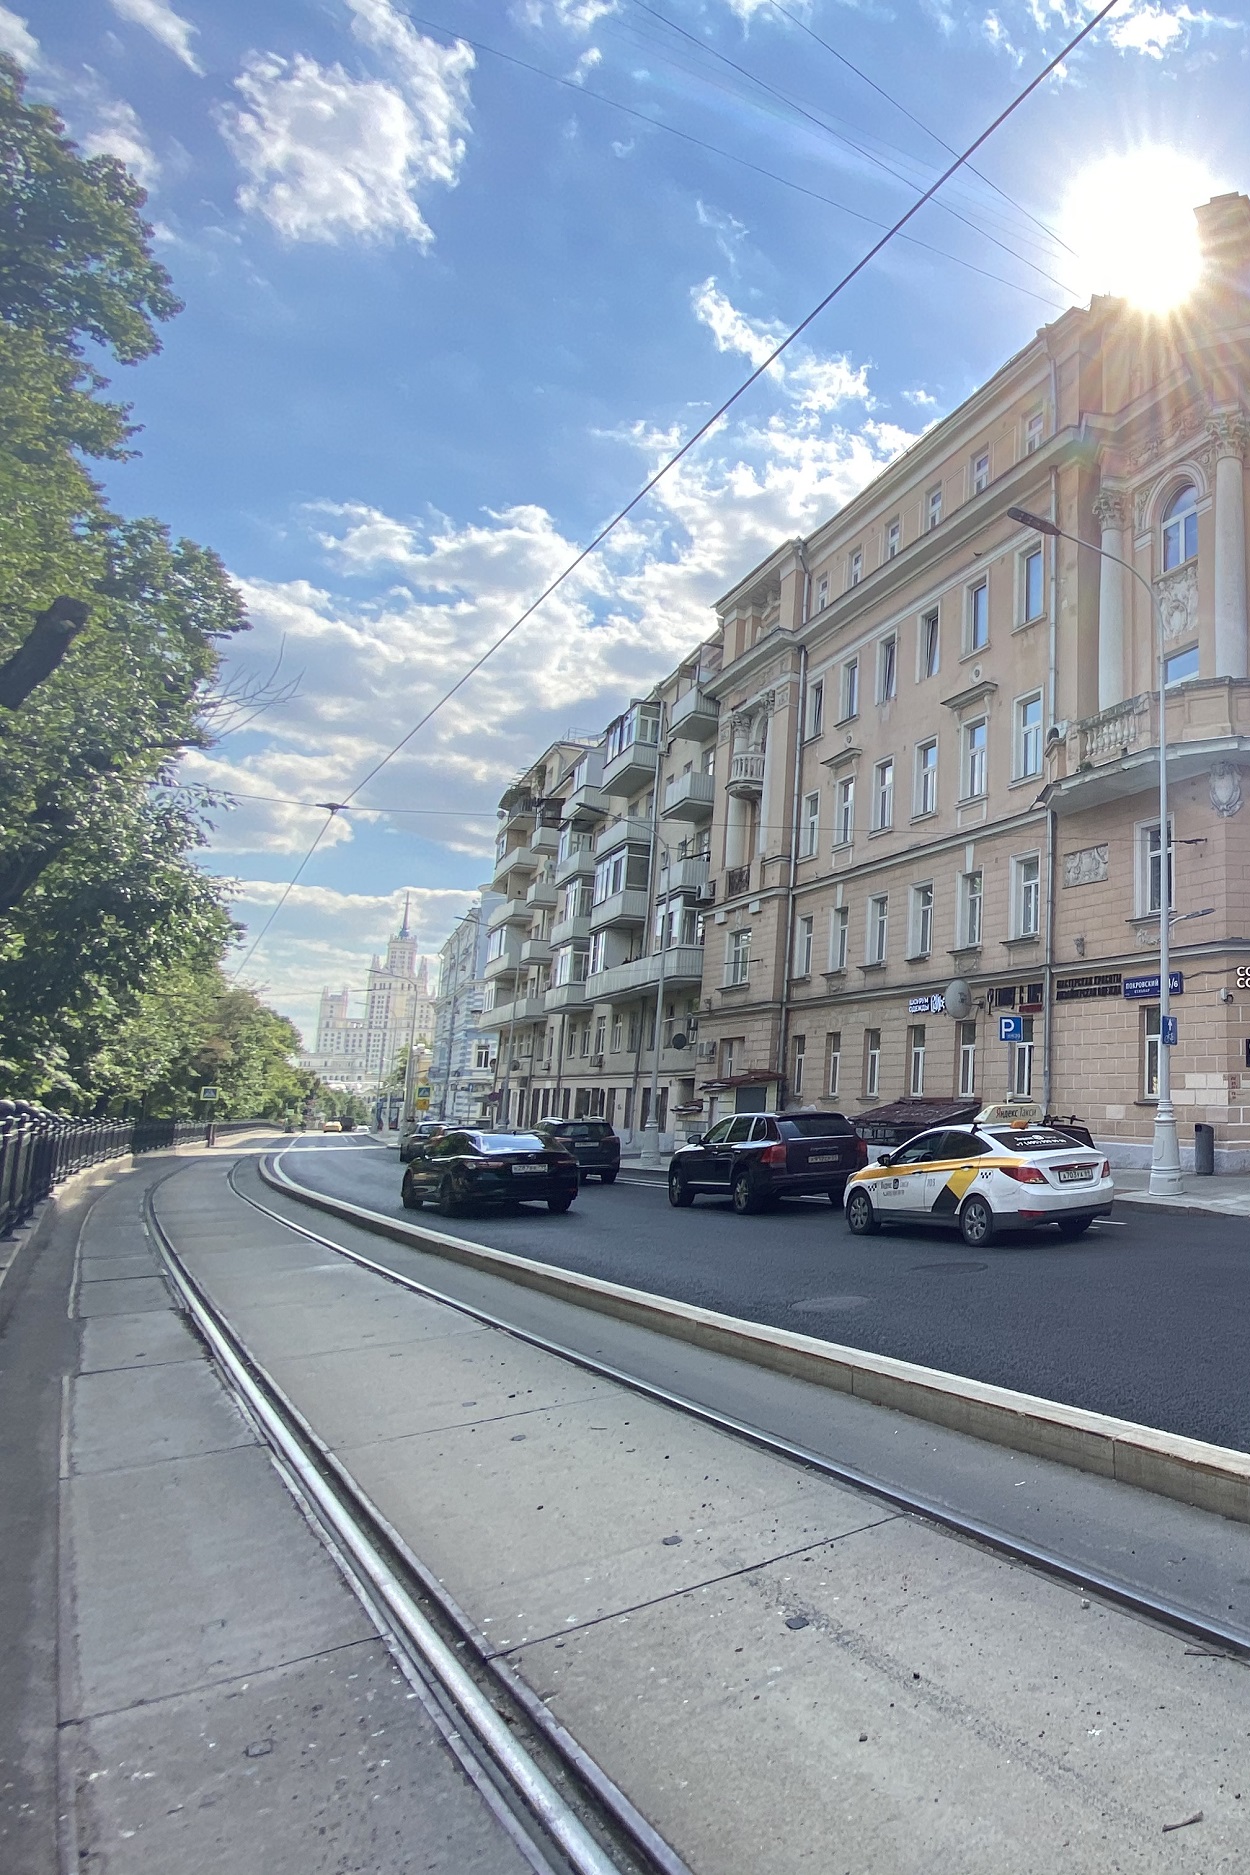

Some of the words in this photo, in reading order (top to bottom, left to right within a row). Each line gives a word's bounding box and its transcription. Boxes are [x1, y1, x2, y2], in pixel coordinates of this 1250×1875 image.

[1125, 978, 1159, 990] ПОКРОВСКИЙ
[995, 1106, 1018, 1118] Яндекс
[1019, 1106, 1037, 1117] Такси
